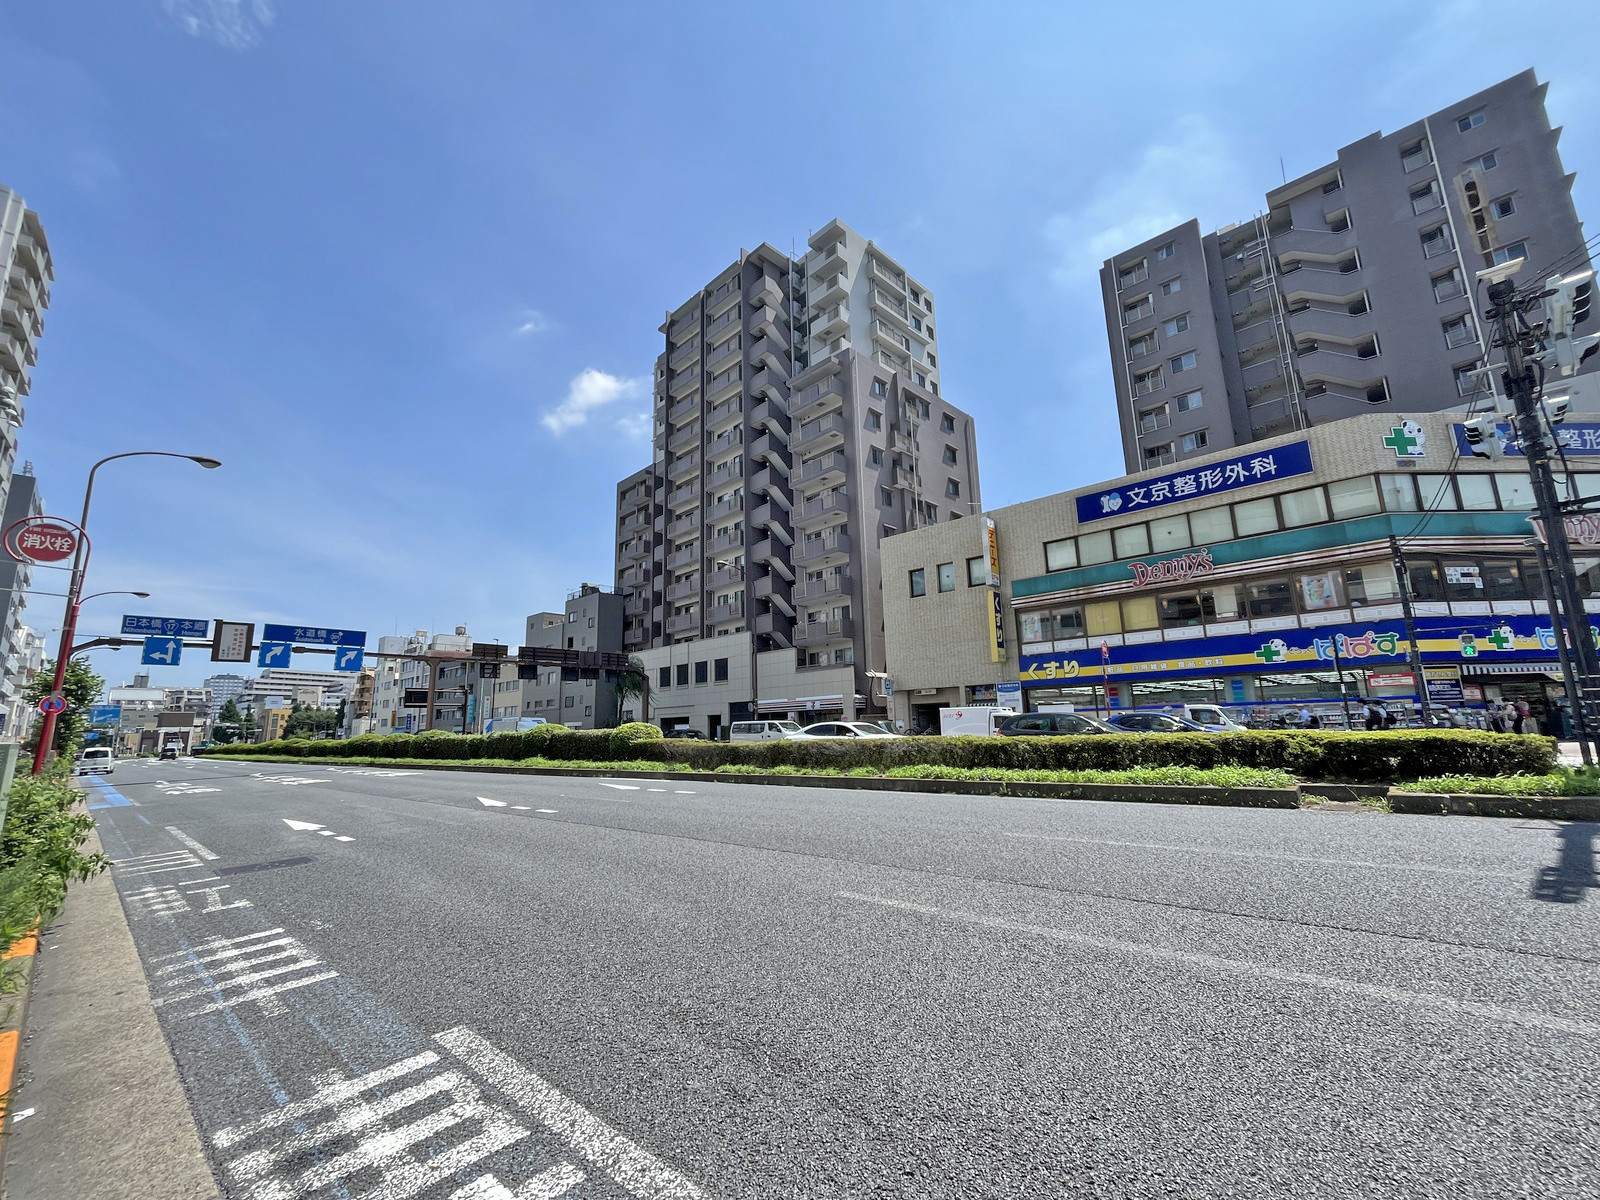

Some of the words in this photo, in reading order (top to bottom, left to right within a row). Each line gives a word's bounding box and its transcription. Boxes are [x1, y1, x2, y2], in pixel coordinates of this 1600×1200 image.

[1126, 454, 1278, 508] 文京整形外科
[22, 533, 73, 553] 消火栓
[1128, 548, 1214, 587] Denny's
[126, 617, 162, 629] 日本橋
[181, 620, 206, 631] 本郷
[994, 597, 1003, 643] くすり
[294, 628, 327, 638] 水道橋
[1313, 631, 1399, 661] ぱぱす
[1027, 660, 1080, 680] くすり
